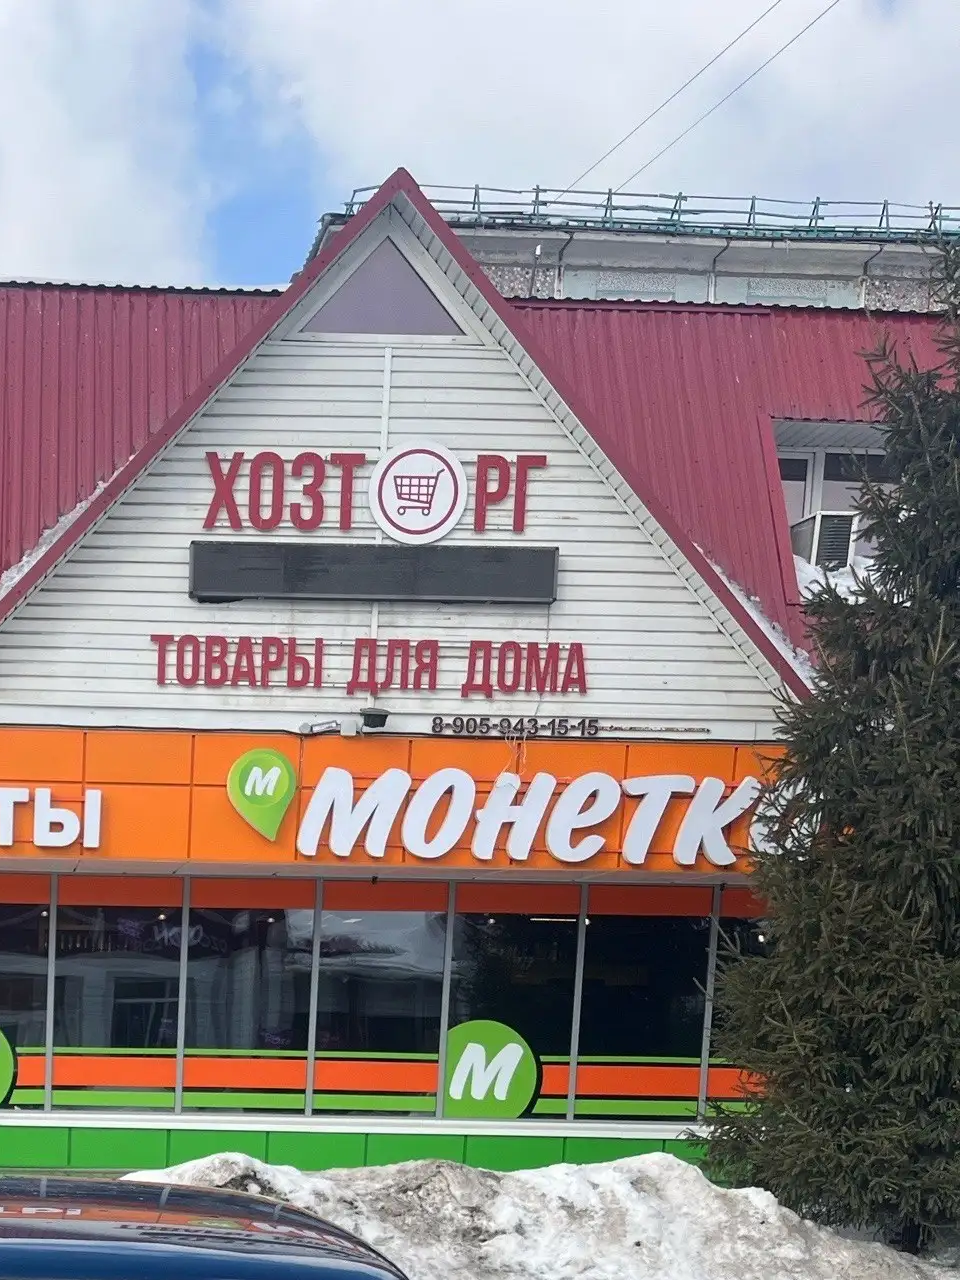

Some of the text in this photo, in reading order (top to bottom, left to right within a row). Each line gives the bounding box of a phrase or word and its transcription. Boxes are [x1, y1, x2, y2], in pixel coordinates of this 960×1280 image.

[150, 634, 588, 699] ТОВАРЫ ДЛЯ ДОМА
[431, 716, 600, 737] 8-905-943-15-15
[448, 1042, 524, 1101] М
